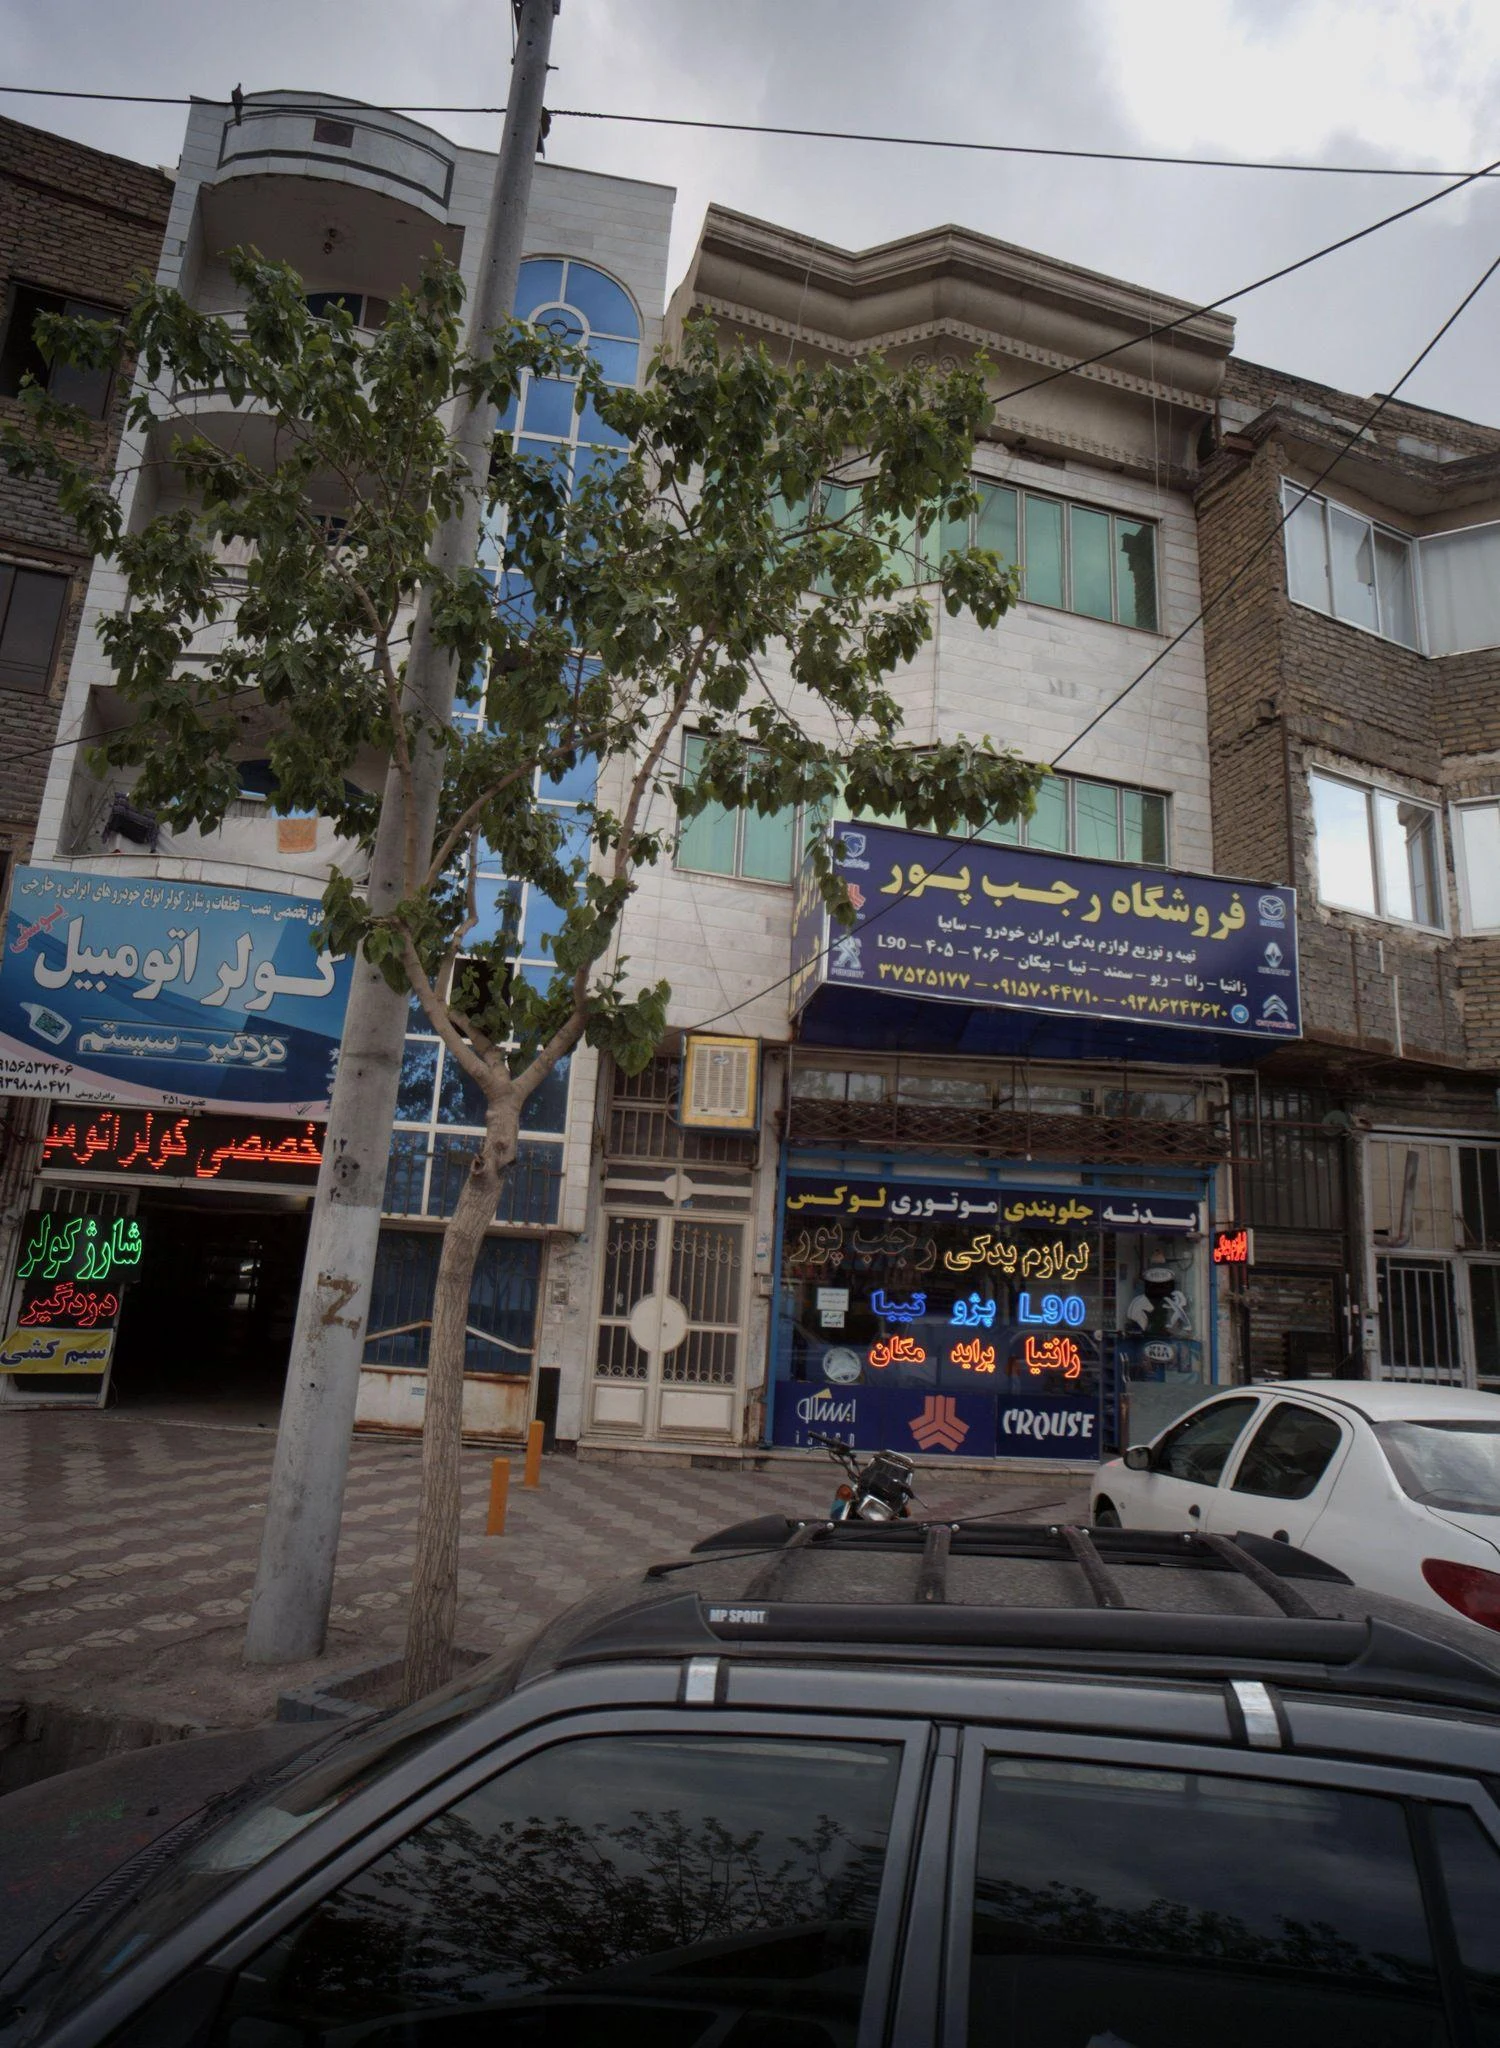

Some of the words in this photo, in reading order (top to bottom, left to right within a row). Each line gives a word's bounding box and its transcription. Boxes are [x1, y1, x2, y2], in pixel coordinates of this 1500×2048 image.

[21, 875, 55, 895] خارجی
[63, 880, 91, 899] ایرانی
[141, 888, 164, 907] انواع
[880, 864, 972, 906] پور
[164, 890, 184, 909] کولر
[982, 875, 1101, 922] رجب
[1112, 881, 1245, 940] فروشگاه
[937, 915, 967, 932] سایپا
[985, 926, 1024, 941] خودرو
[1027, 928, 1060, 945] ایران
[877, 934, 907, 950] L90
[926, 940, 954, 957] ۴۰۵
[972, 946, 999, 962] ۲۰۶
[1061, 934, 1095, 951] یدکی
[1098, 939, 1129, 955] لوازم
[1132, 945, 1163, 960] توزیع
[33, 915, 200, 1000] اتومبیل
[1018, 955, 1051, 973] پیکان
[1068, 960, 1087, 976] تیبا
[1166, 951, 1173, 962] و
[1175, 950, 1197, 963] تهیه
[200, 931, 346, 1012] کولر
[879, 963, 970, 989] ۳۷۵۲۵۱۷۷
[1150, 974, 1169, 988] ریو
[1185, 973, 1204, 992] رانا
[1220, 978, 1248, 997] زانتیا
[78, 1022, 179, 1057] سیستم
[117, 1111, 190, 1170] کولر
[787, 1185, 887, 1213] لوکس
[891, 1191, 998, 1219] موتوری
[1004, 1198, 1094, 1225] جلوبندی
[1102, 1202, 1196, 1232] بدنه
[18, 1213, 82, 1278] کولر
[77, 1218, 142, 1280] شارژ
[789, 1222, 843, 1267] پور
[944, 1234, 1018, 1273] یدکی
[1022, 1241, 1090, 1280] لوازم
[20, 1282, 118, 1326] دزدگیر
[871, 1289, 927, 1323] تیبا
[949, 1291, 997, 1328] پژو
[1018, 1292, 1086, 1326] L90
[0, 1339, 60, 1365] کشی
[65, 1348, 107, 1366] سیم
[951, 1338, 996, 1373] پراید
[1025, 1335, 1081, 1378] زانتیا
[1002, 1408, 1095, 1440] CROUSE
[729, 1609, 766, 1623] SPORT
